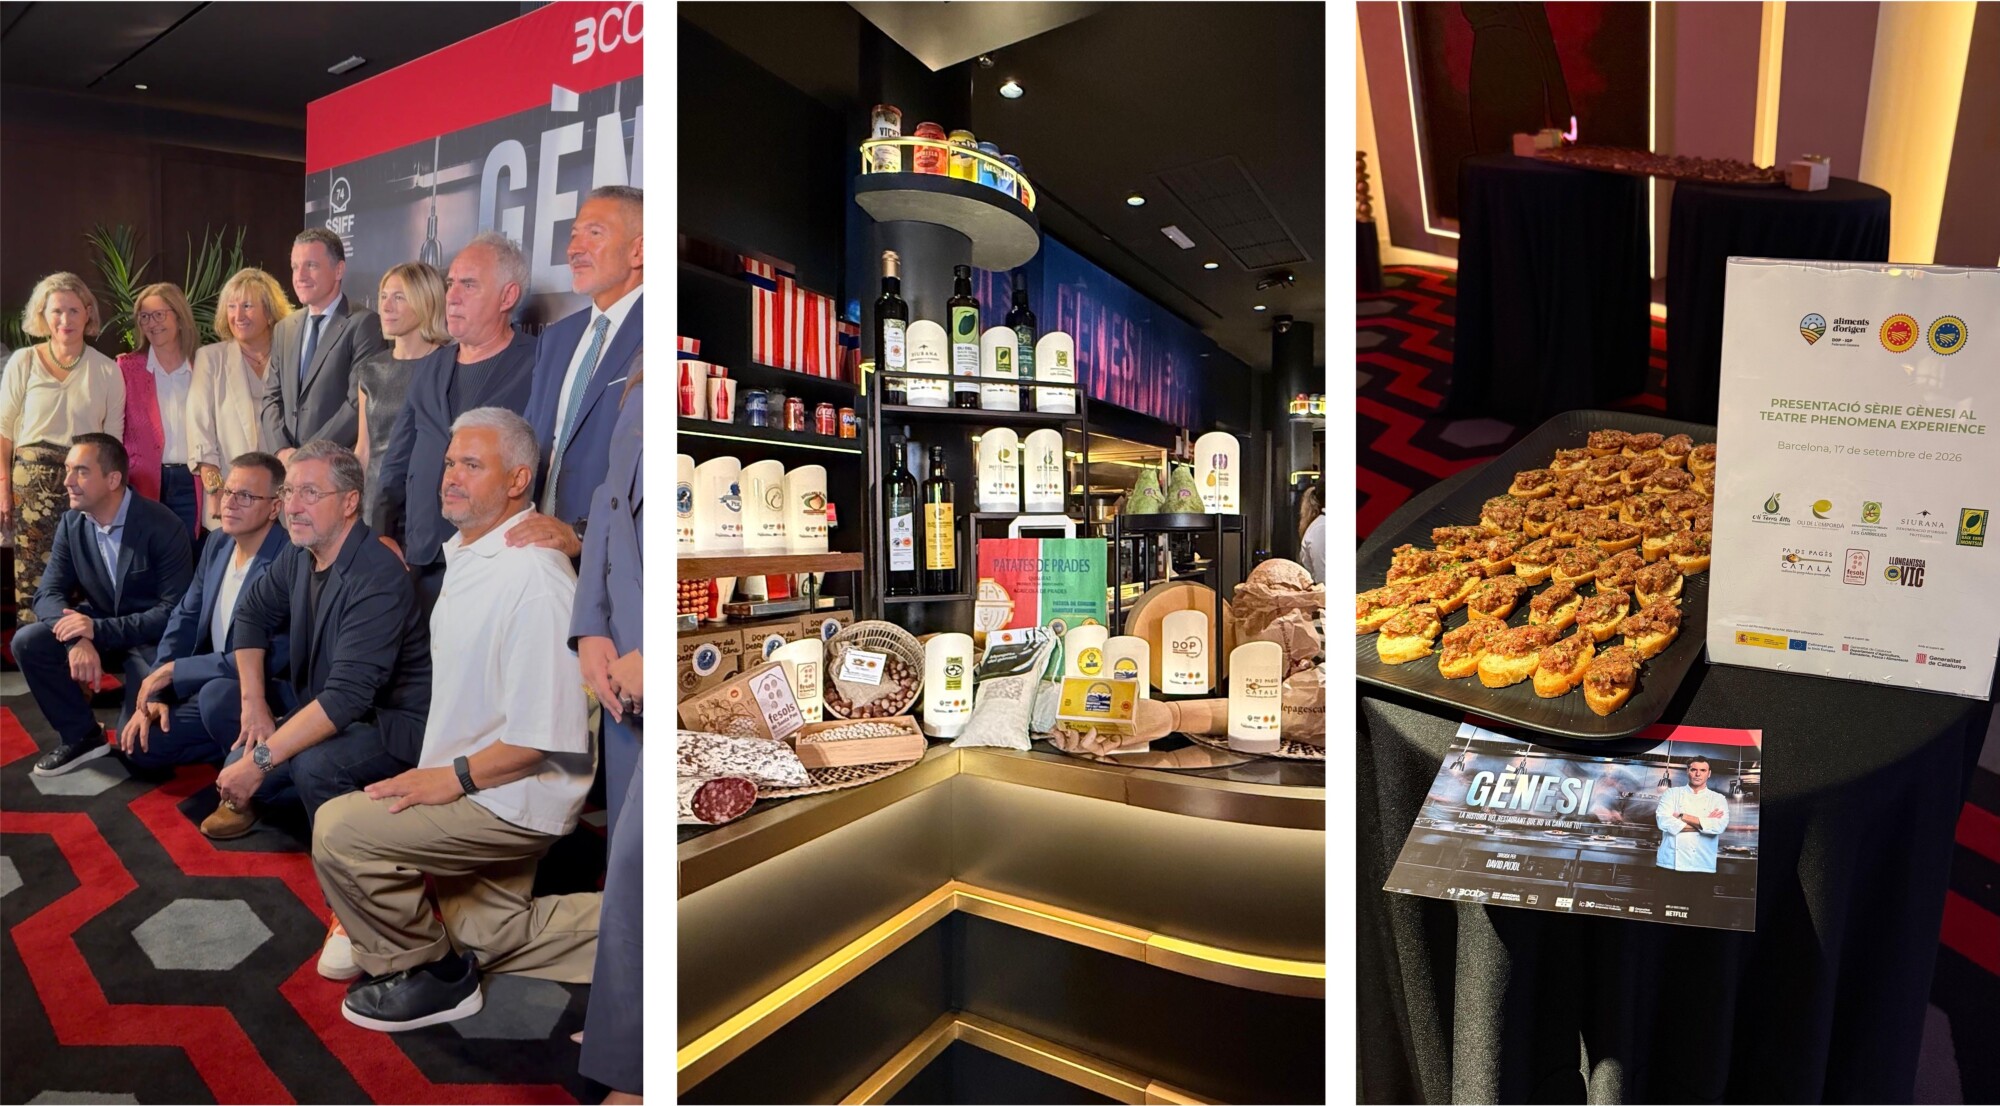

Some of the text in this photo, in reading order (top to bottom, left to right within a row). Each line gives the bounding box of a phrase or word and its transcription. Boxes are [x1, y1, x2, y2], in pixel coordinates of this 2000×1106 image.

[336, 188, 345, 200] 74
[326, 214, 354, 233] SSIFF
[1833, 318, 1869, 326] aliments
[1833, 325, 1866, 334] d'origen
[1771, 398, 1976, 420] PRESENTACIÓ SÈRIE GÈNESI AL
[1760, 411, 1986, 435] TEATRE PHENOMENA EXPERIENCE
[1778, 441, 1962, 462] Barcelona, 17 de setembre de 2026
[1901, 519, 1944, 528] SIURANA
[994, 559, 1090, 573] PATATES DE PRADES
[1781, 562, 1831, 573] CATALÀ
[1889, 557, 1926, 568] LLONGANISSA
[1900, 566, 1925, 588] VIC
[1173, 641, 1196, 650] DOP
[1929, 655, 1961, 664] Generalitat
[1937, 662, 1966, 670] Catalunya
[768, 703, 795, 723] fesols
[1466, 765, 1595, 815] GÈNESI
[1498, 815, 1526, 824] RESTAURANT
[1552, 820, 1573, 828] CANVIAR
[1486, 859, 1520, 871] DAVID PUJOL
[1665, 910, 1688, 918] NETFLIX
